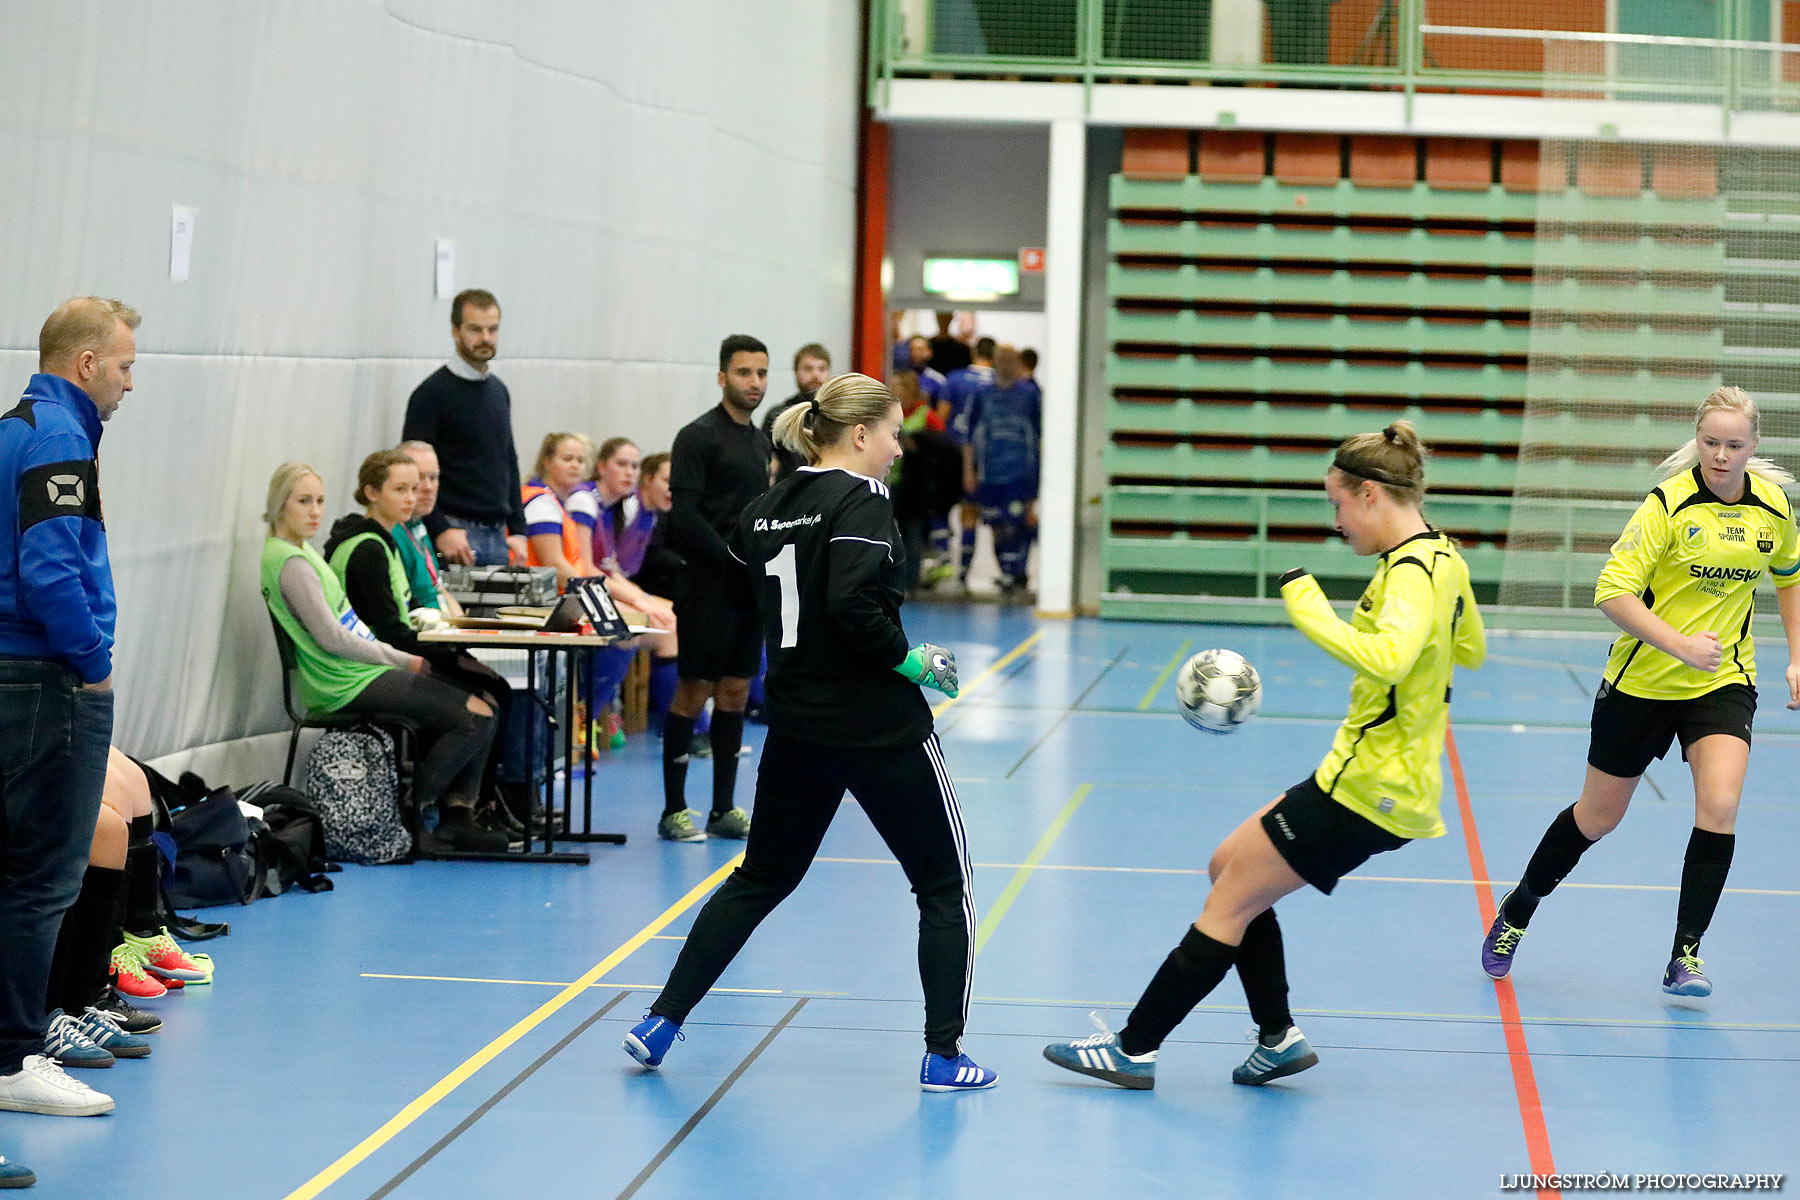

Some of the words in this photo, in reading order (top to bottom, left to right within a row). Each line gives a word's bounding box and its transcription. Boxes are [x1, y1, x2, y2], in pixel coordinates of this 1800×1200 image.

[753, 518, 769, 532] ICA
[1726, 526, 1745, 535] TEAM
[1718, 533, 1746, 542] SPORTIA
[764, 543, 800, 649] 1
